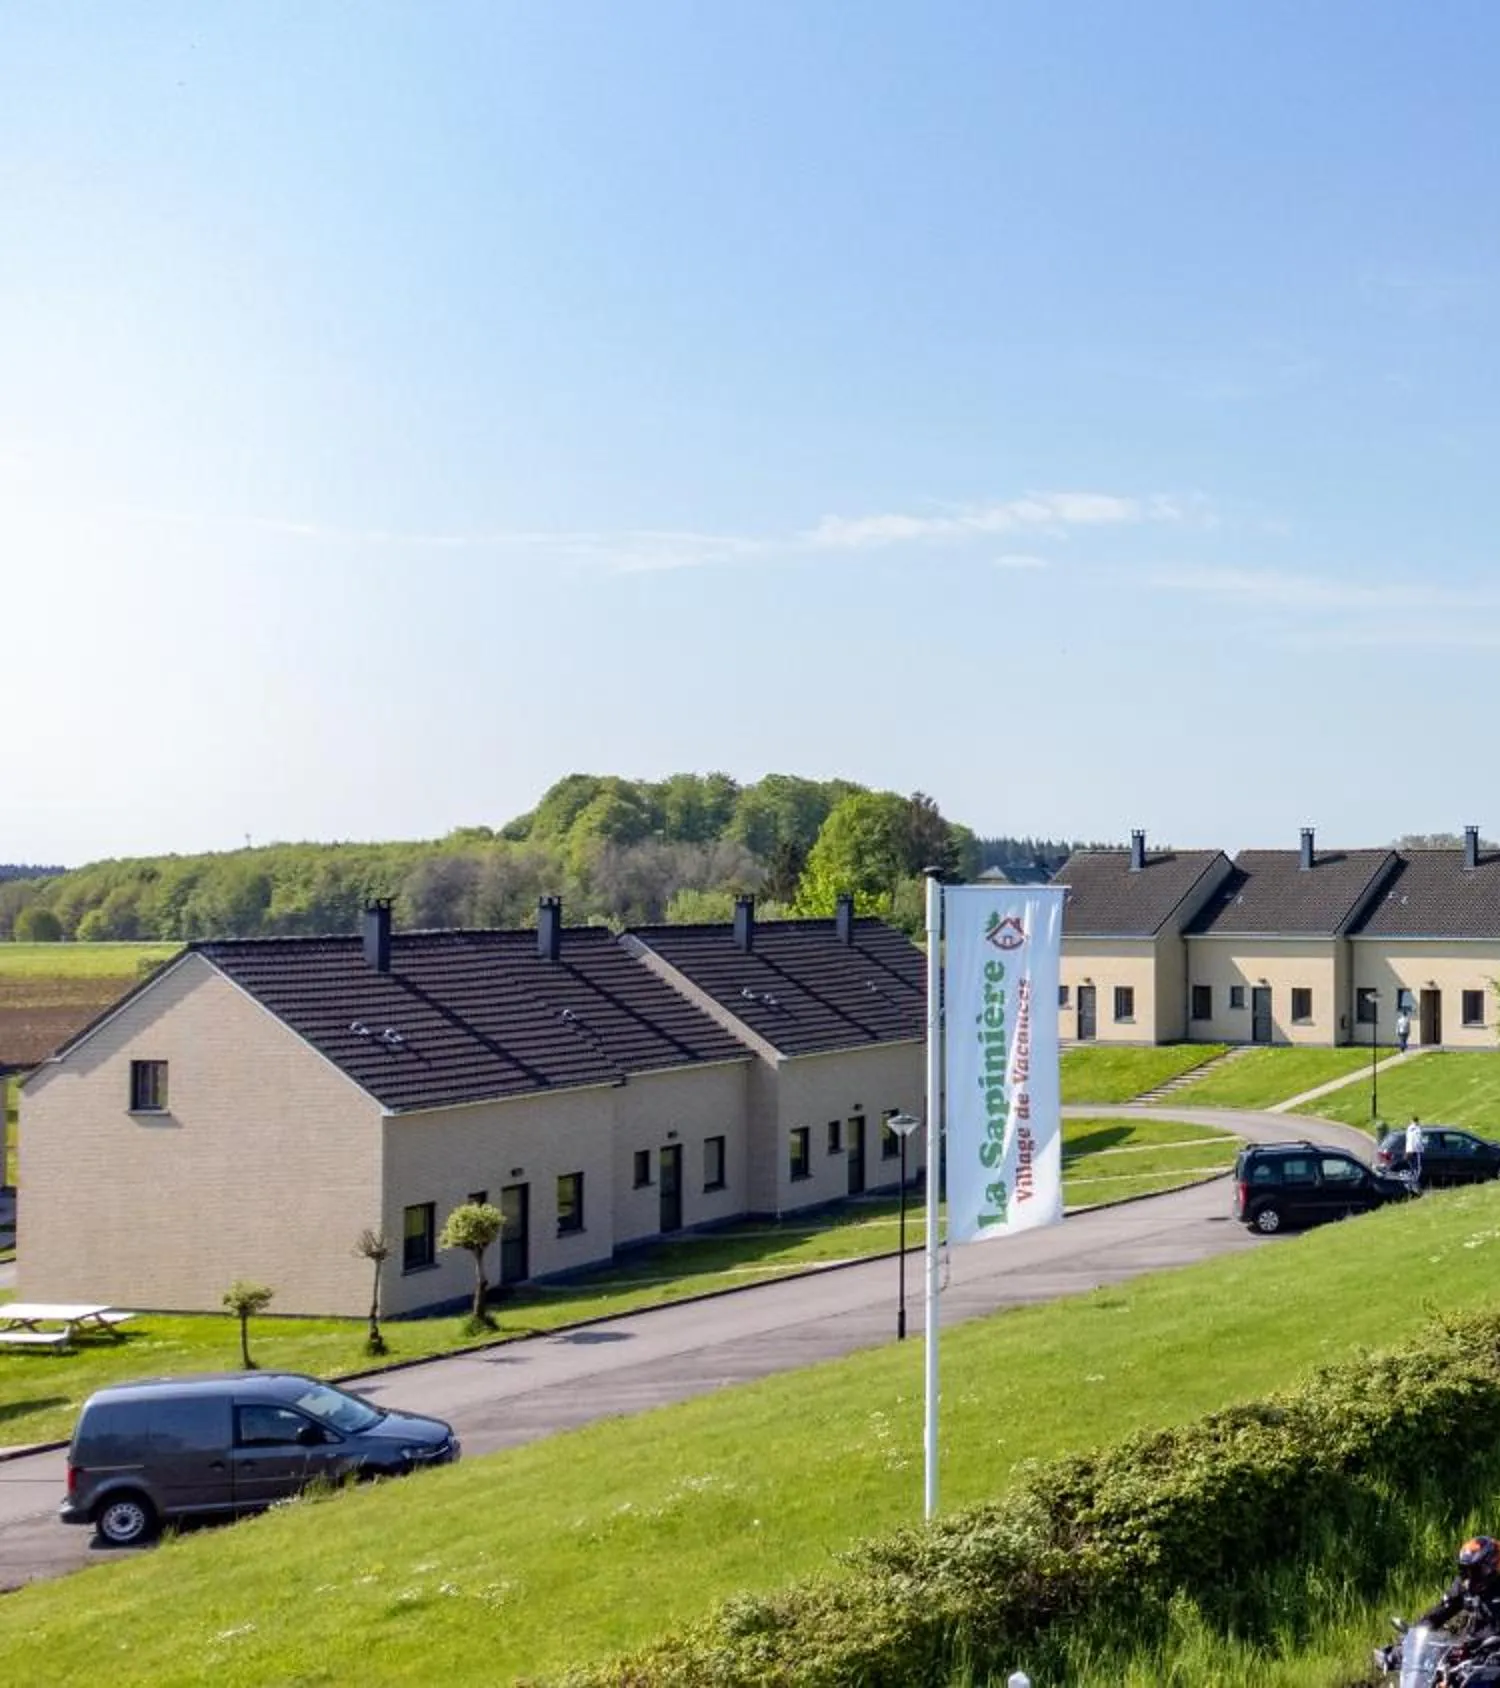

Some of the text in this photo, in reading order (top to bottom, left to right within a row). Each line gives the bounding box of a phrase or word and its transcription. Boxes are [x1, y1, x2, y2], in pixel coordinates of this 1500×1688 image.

[976, 959, 1010, 1229] La Sapinière
[1012, 978, 1035, 1202] Village de Vacances
